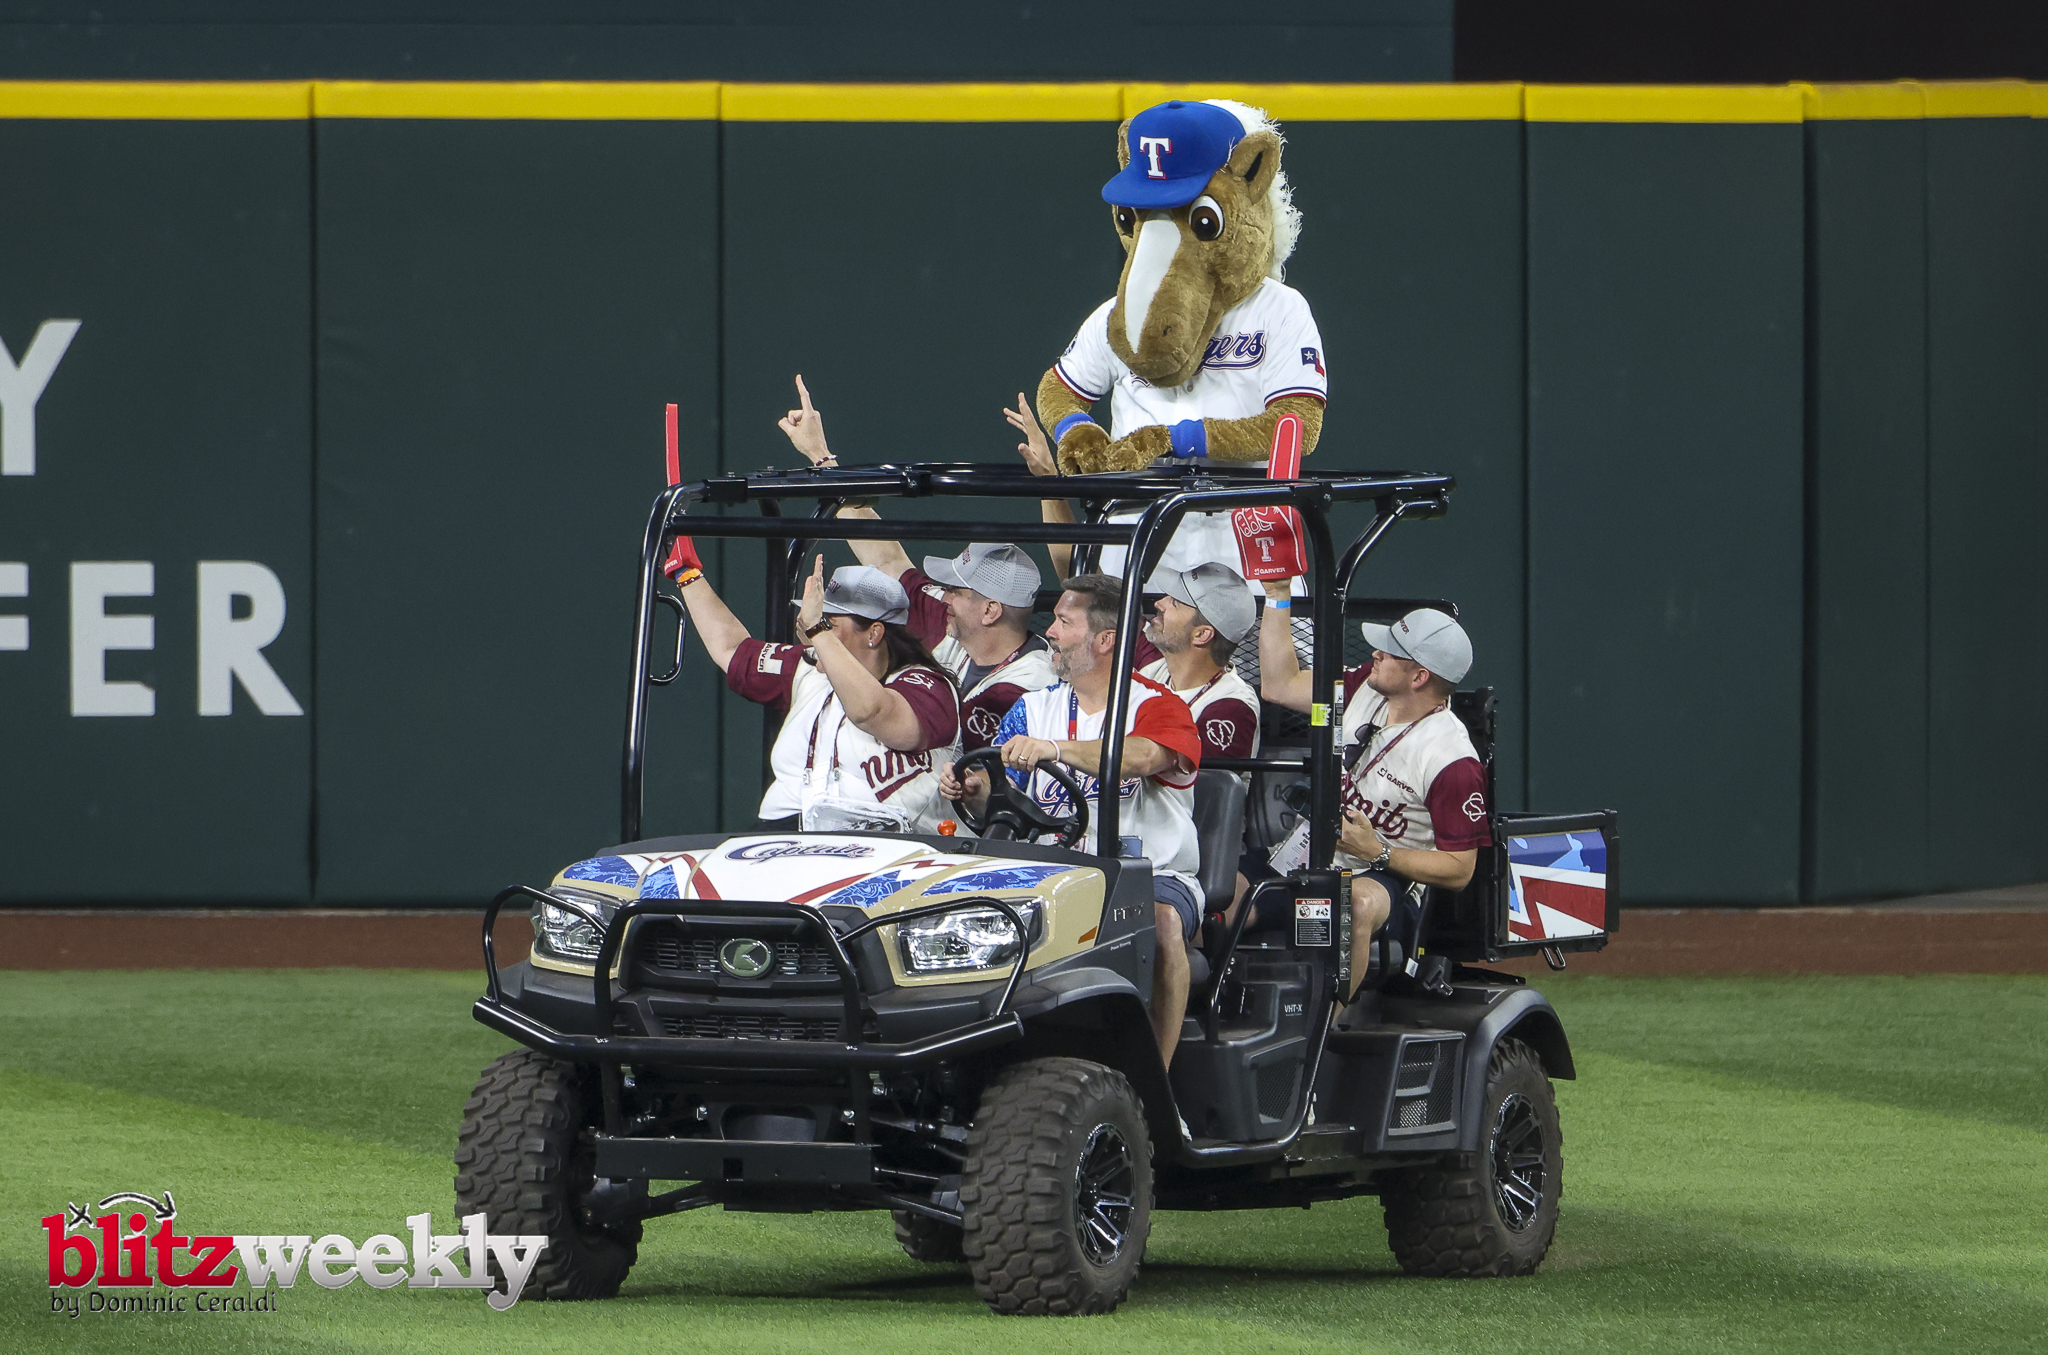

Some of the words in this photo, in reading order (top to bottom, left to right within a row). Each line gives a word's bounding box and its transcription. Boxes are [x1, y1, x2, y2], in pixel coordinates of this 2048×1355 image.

[1139, 136, 1172, 180] T
[0, 319, 81, 475] Y
[1254, 536, 1275, 563] T
[1259, 567, 1286, 575] GARVER
